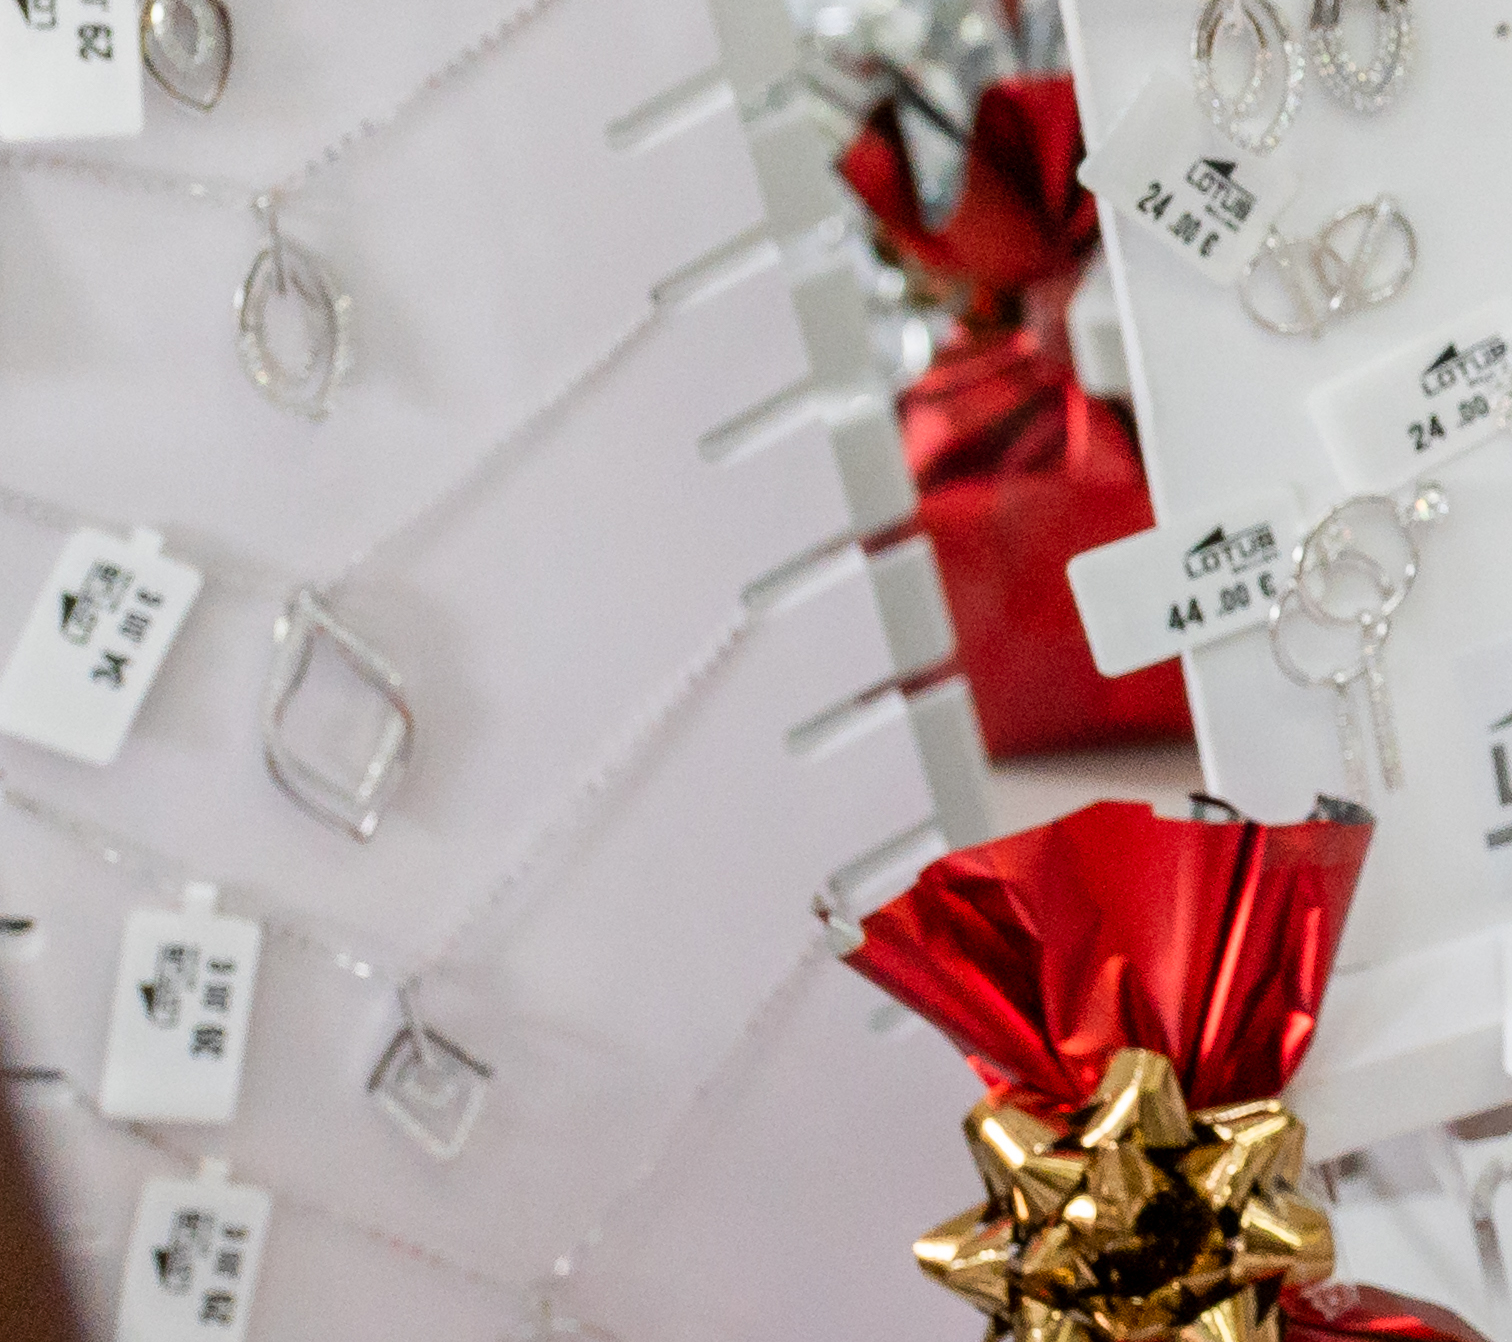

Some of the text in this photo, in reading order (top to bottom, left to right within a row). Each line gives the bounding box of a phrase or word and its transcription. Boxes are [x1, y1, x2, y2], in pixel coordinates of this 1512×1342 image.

[76, 22, 113, 61] 29
[1135, 180, 1174, 221] 24
[1407, 412, 1447, 453] 24
[1166, 597, 1205, 632] 44
